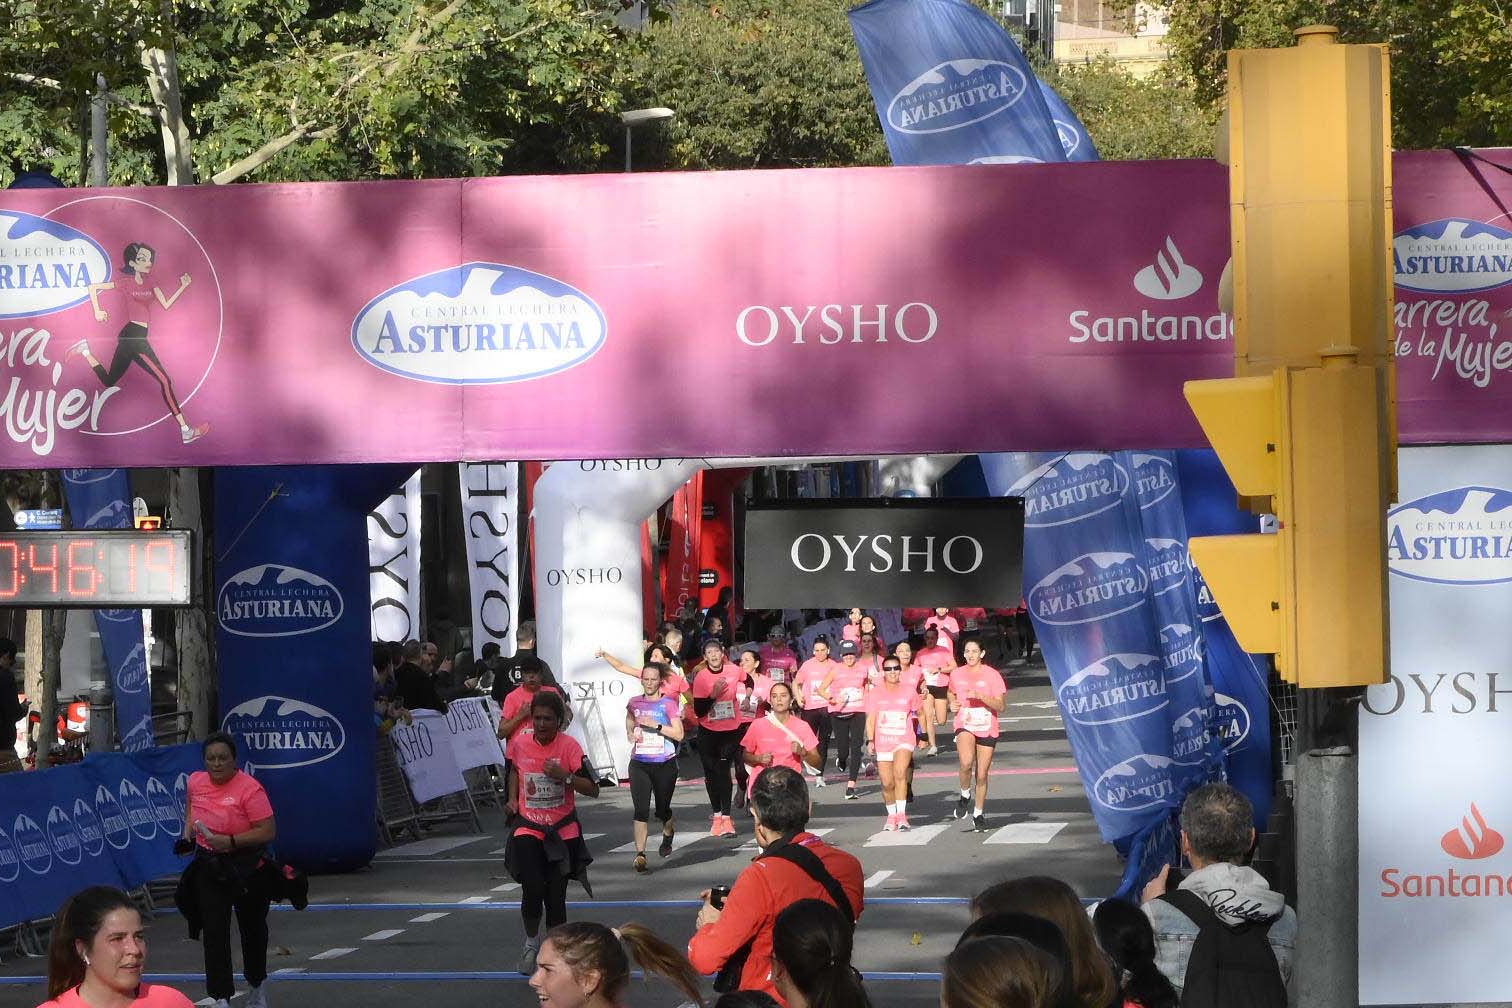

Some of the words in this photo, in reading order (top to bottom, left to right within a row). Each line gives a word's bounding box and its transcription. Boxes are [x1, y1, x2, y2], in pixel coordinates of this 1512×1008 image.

[14, 246, 86, 258] LECHERA
[1465, 242, 1512, 252] LECHER
[411, 305, 486, 318] CENTRAL
[498, 302, 579, 317] LECHERA
[1394, 298, 1490, 329] arrera
[371, 309, 586, 355] ASTURIANA
[735, 301, 938, 346] OYSHO
[1069, 309, 1235, 343] Santand
[1418, 330, 1436, 357] la
[1432, 323, 1512, 388] Muje
[1415, 521, 1483, 531] CENTRAL
[1490, 519, 1512, 529] LEC
[790, 532, 985, 574] OYSHO
[546, 566, 623, 587] OYSHO
[234, 589, 276, 598] CENTRAL
[281, 588, 330, 598] LECHERA
[222, 594, 334, 621] ASTURIANA
[1361, 671, 1512, 716] OYSH
[281, 719, 331, 729] LECHERA
[244, 731, 336, 751] TURIANA
